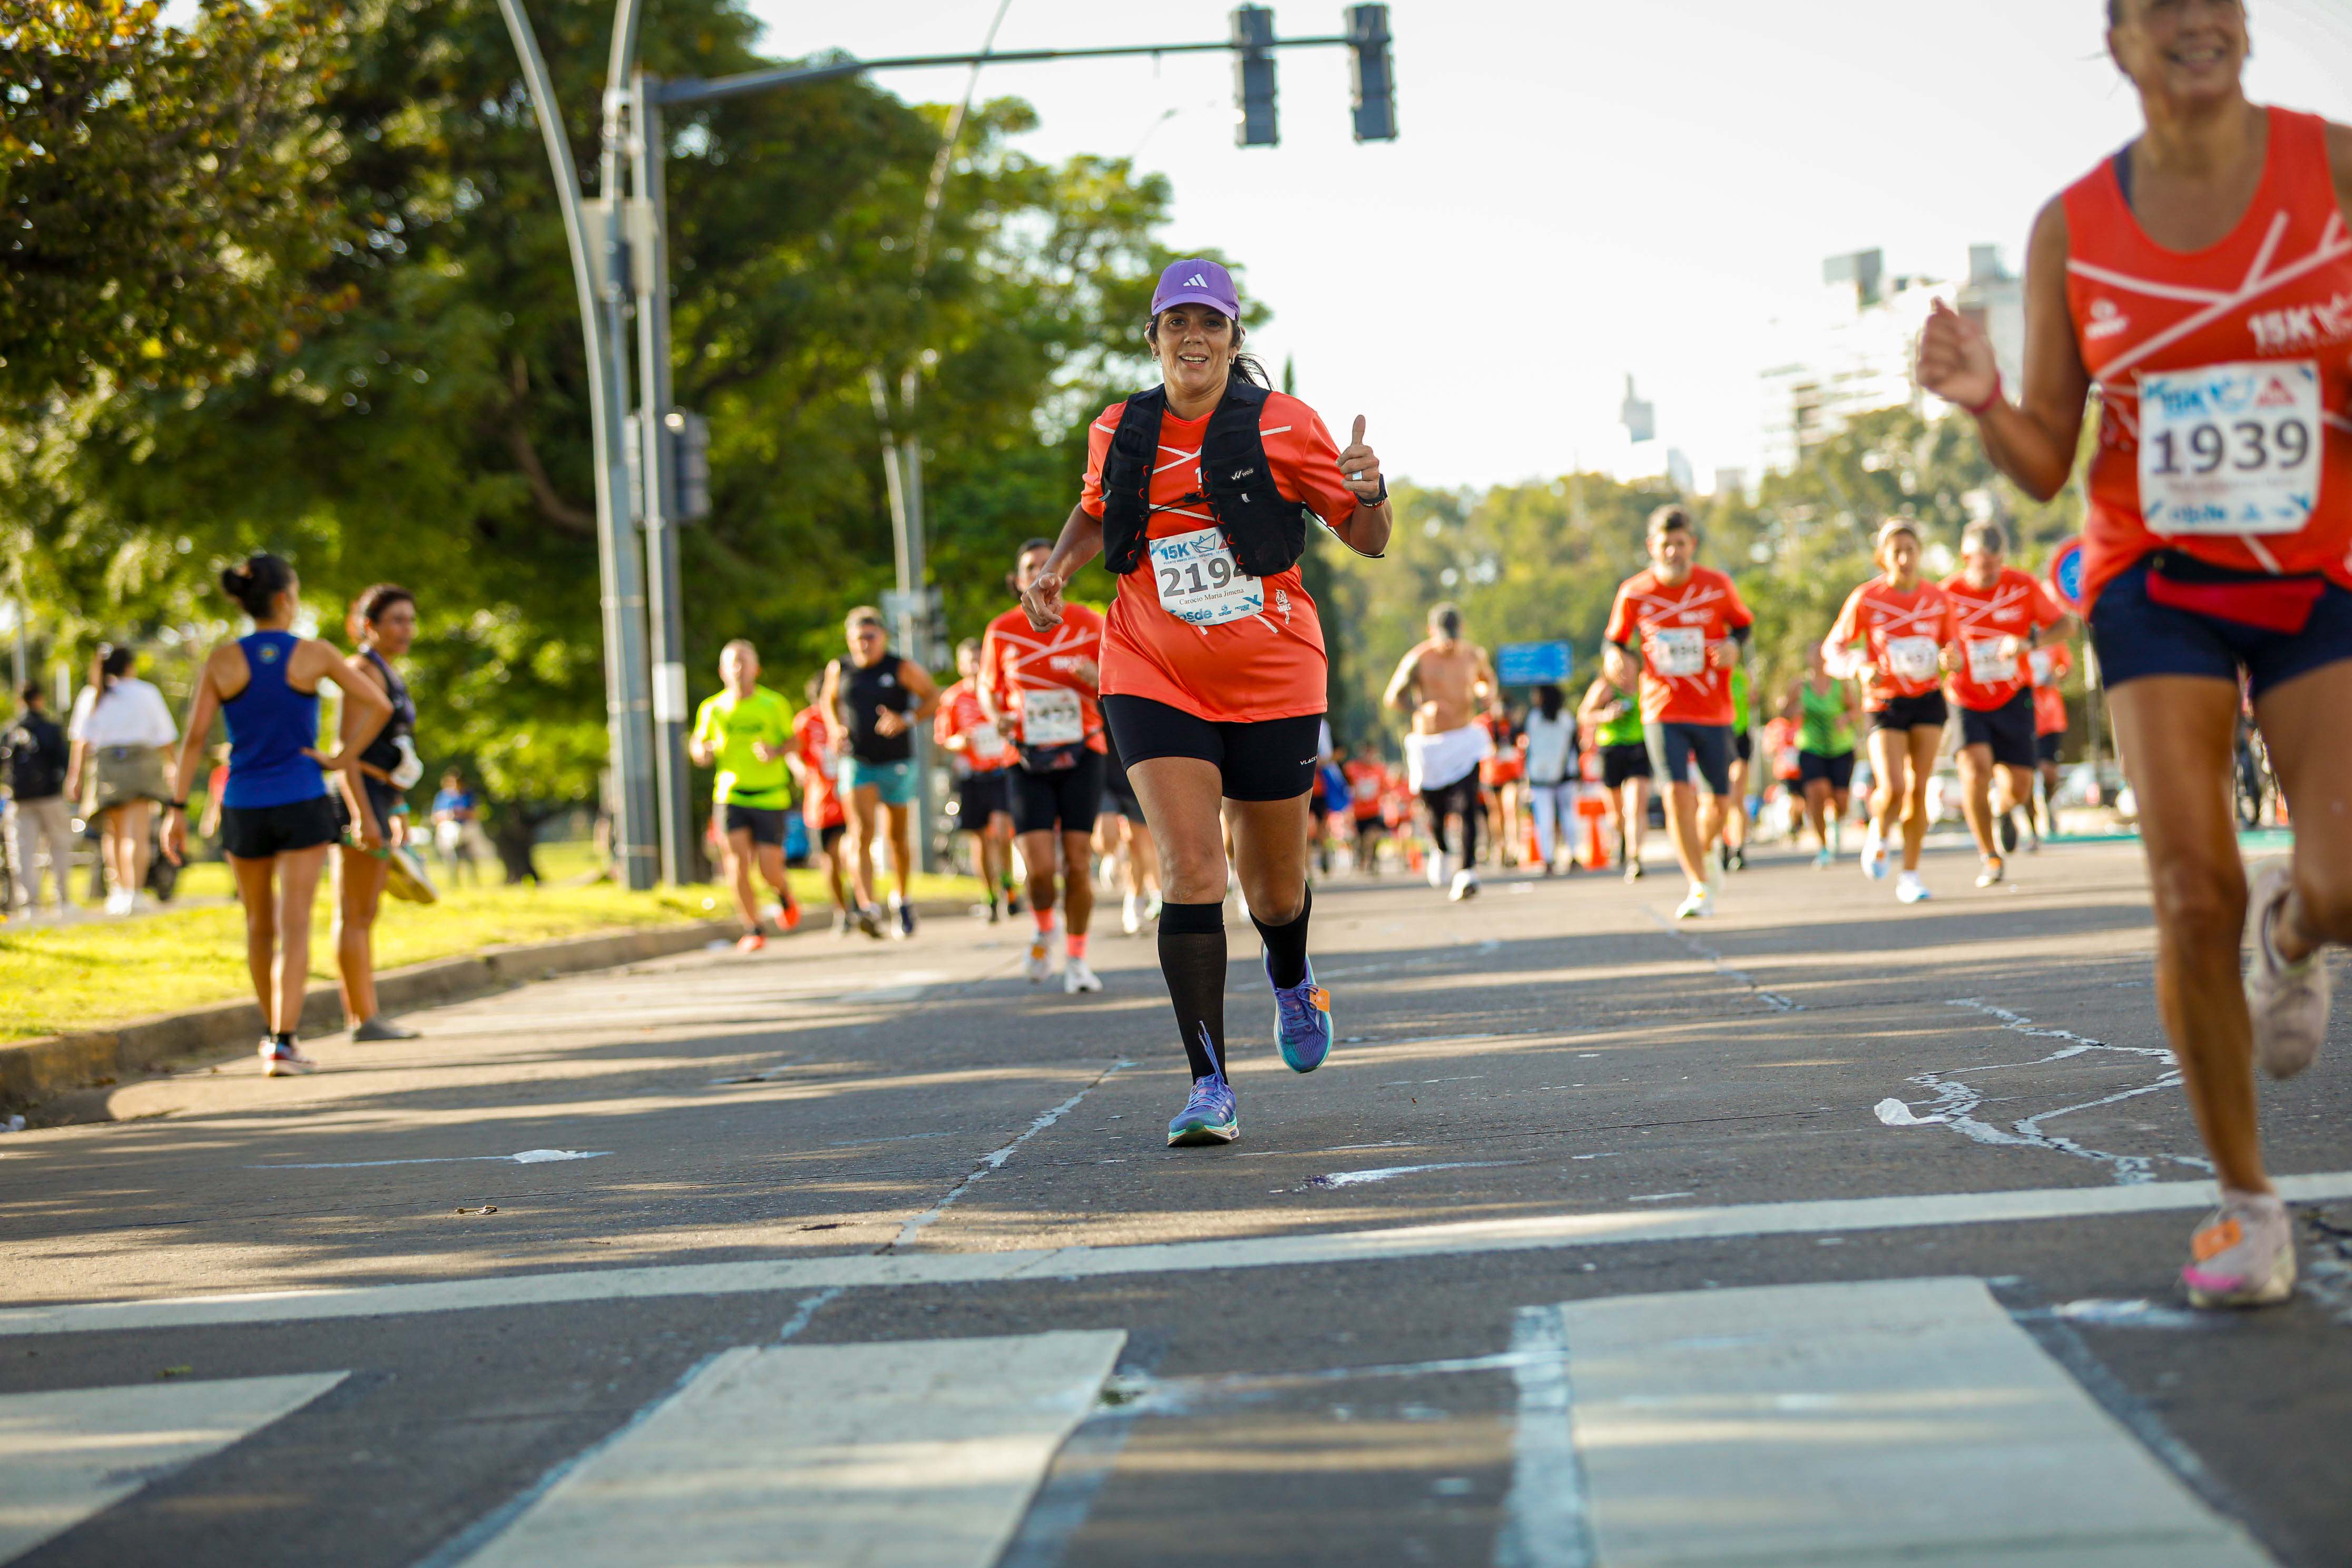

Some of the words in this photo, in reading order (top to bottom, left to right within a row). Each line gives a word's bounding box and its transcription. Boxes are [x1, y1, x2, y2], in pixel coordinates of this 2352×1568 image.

[2152, 419, 2310, 475] 1939
[1160, 542, 1190, 560] 15K
[1224, 588, 1244, 597] Jimena
